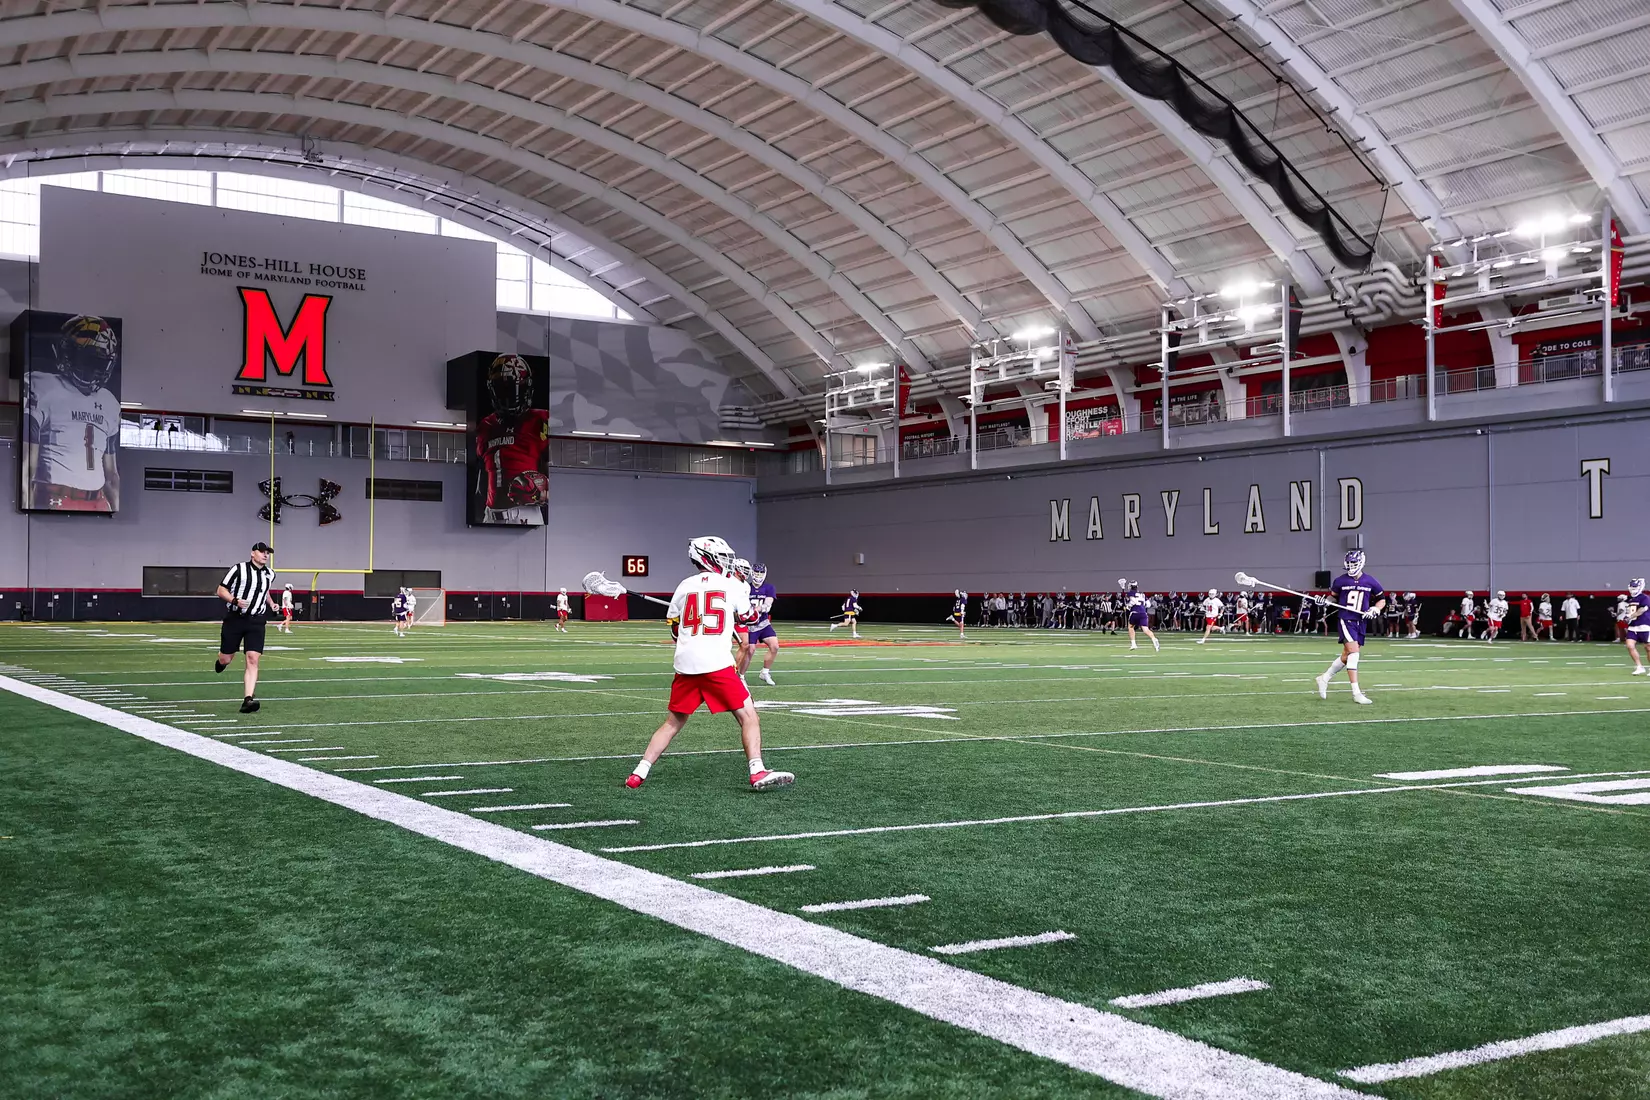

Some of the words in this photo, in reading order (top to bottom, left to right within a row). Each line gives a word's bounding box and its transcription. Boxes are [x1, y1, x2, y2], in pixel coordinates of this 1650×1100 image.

[201, 252, 303, 274] JONES-HILL
[310, 263, 366, 281] HOUSE
[201, 267, 232, 277] HOME
[237, 271, 250, 279] OF
[254, 272, 311, 285] MARYLAND
[315, 279, 366, 291] FOOTBALL
[234, 285, 334, 387] M
[1560, 342, 1570, 350] TO
[1572, 340, 1592, 348] COLE
[72, 410, 105, 425] MARYLAND
[1065, 406, 1108, 418] OUGHNESS
[1049, 477, 1364, 542] MARYLAND
[627, 558, 646, 573] 66
[1346, 590, 1365, 612] 91
[682, 590, 727, 636] 45
